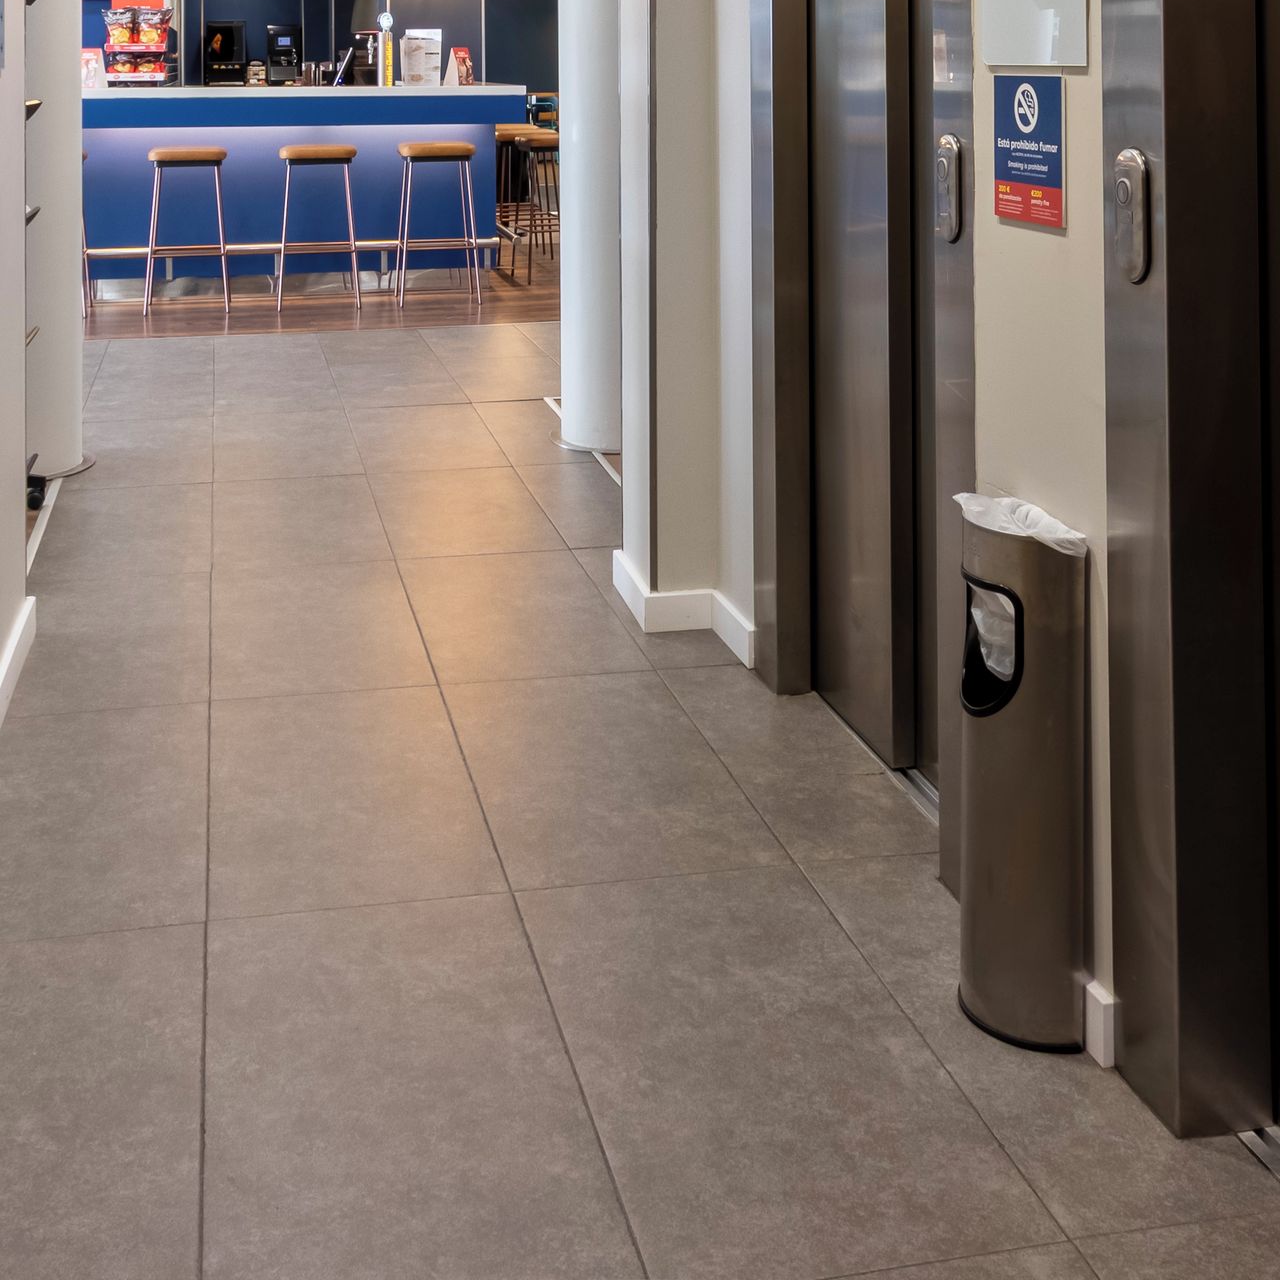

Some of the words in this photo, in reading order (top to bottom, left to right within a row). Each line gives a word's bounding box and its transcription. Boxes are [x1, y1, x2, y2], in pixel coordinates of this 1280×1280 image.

[997, 137, 1010, 148] Está
[1010, 140, 1039, 151] prohibido
[1039, 141, 1058, 153] fumar
